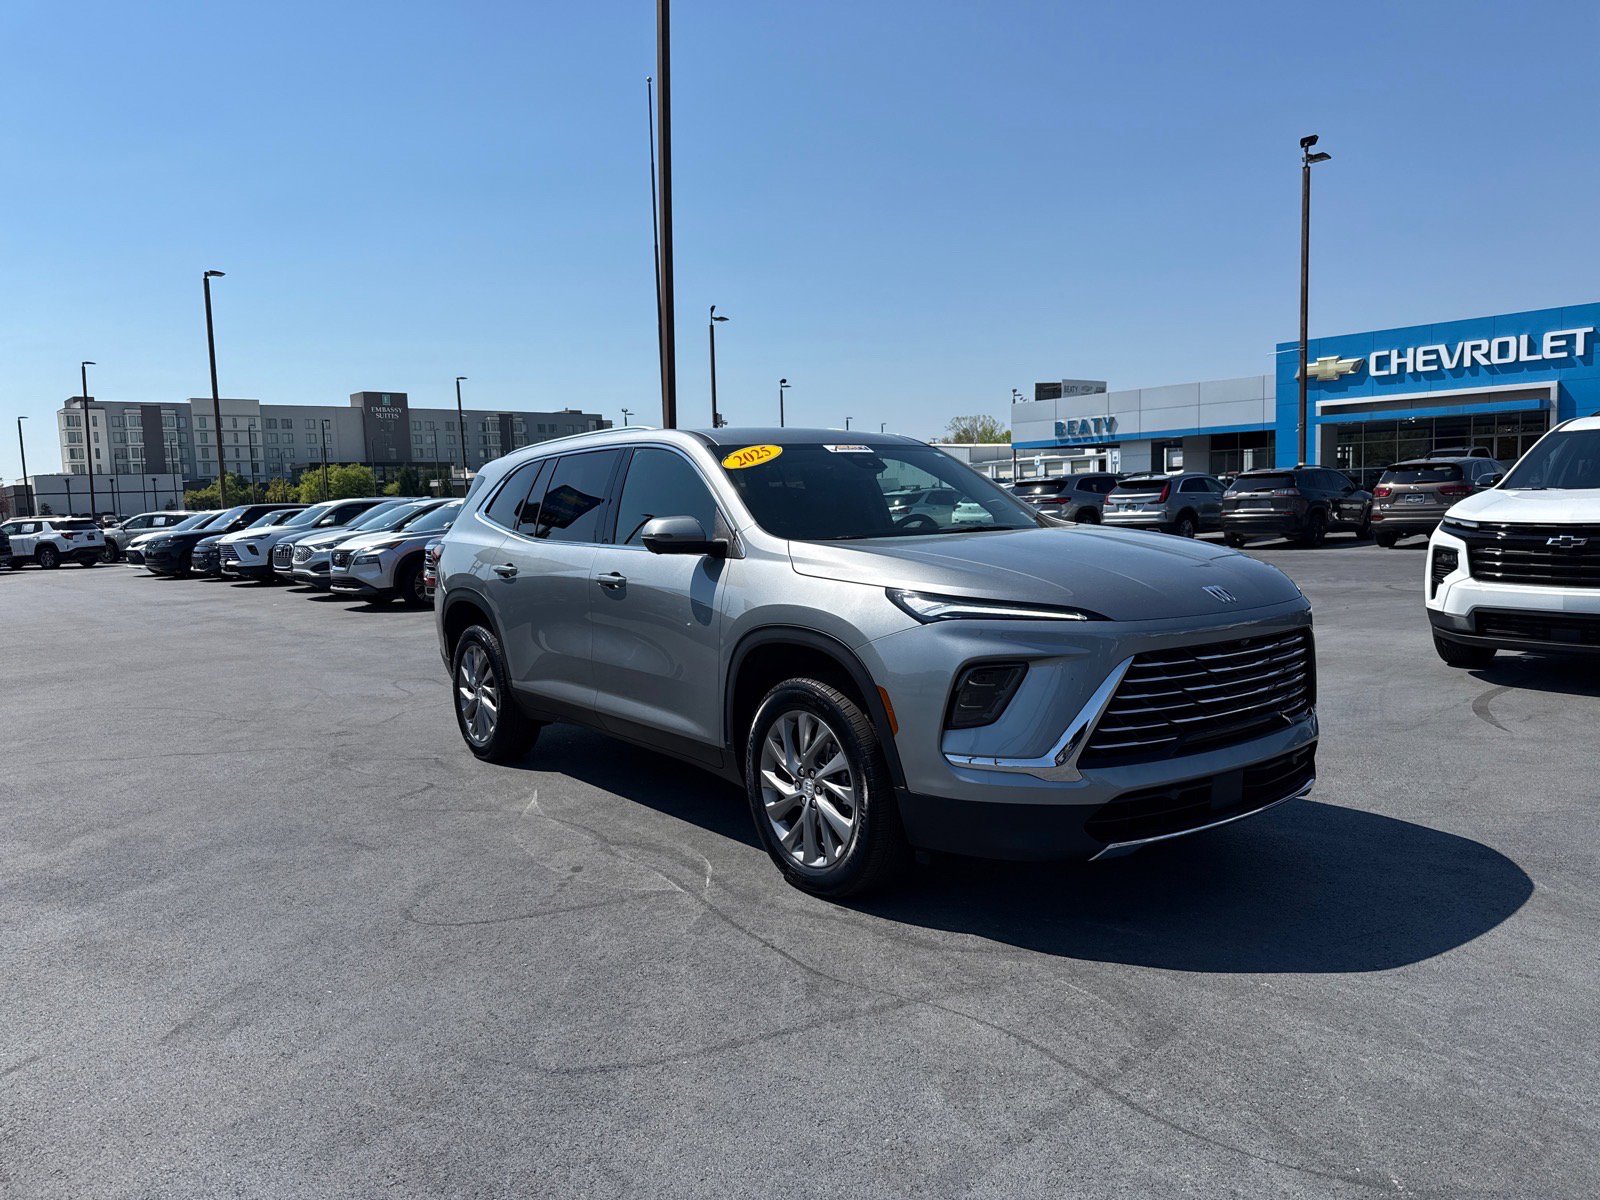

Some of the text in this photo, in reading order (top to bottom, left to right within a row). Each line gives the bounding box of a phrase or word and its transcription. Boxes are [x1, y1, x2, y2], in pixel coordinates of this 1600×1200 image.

[1369, 327, 1594, 377] CHEVROLET
[1055, 416, 1117, 437] BEATY
[733, 446, 772, 467] 2025
